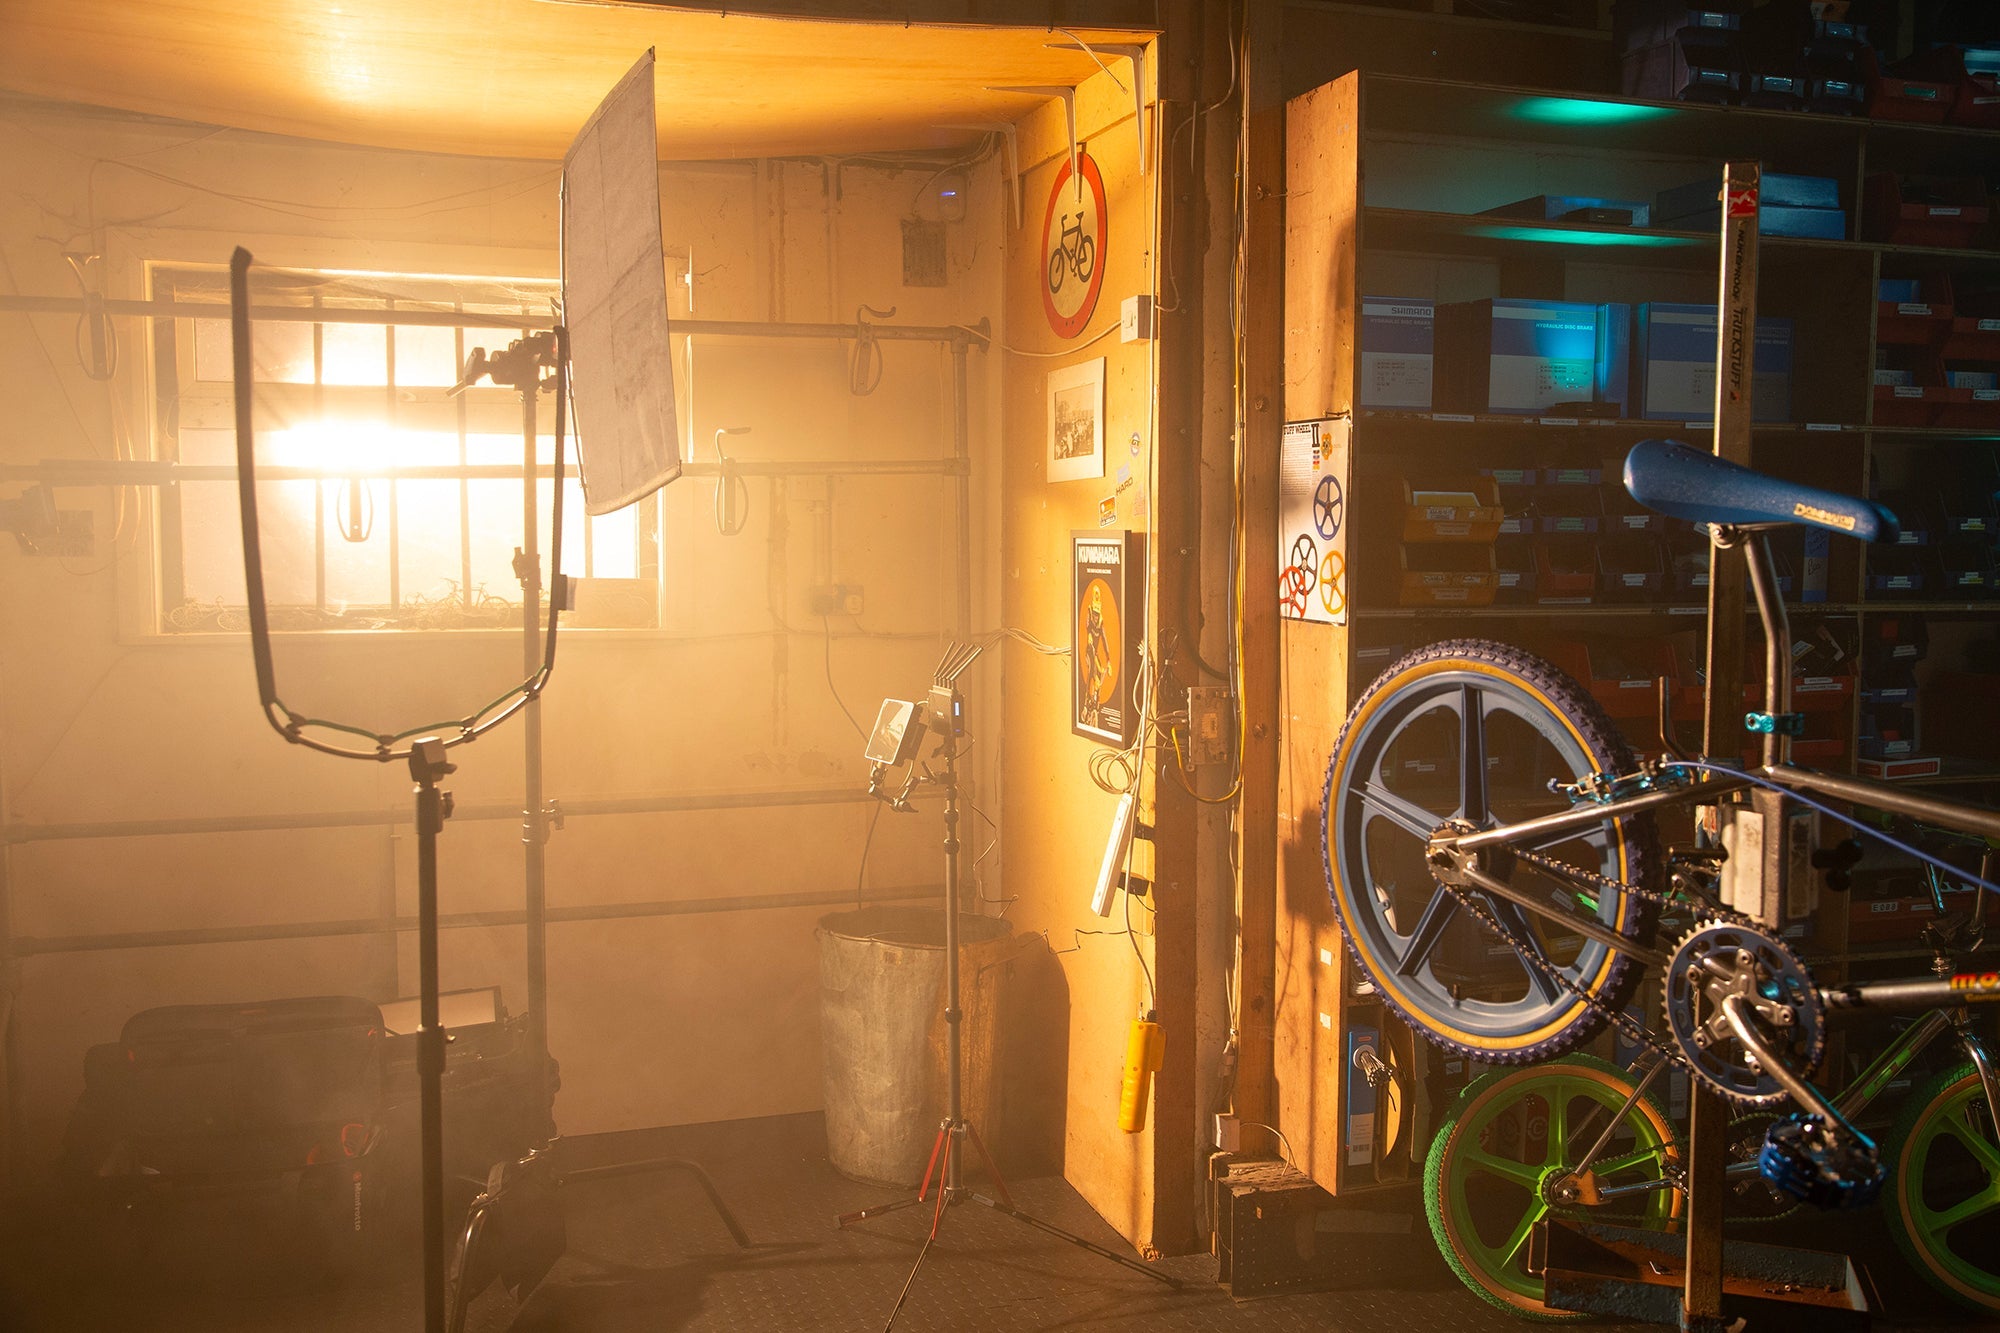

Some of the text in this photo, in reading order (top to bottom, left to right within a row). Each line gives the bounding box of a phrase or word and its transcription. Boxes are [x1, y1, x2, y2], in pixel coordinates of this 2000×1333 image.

[1733, 229, 1746, 302] NUKEPROOF
[1391, 306, 1432, 316] SHIMANO
[1535, 322, 1563, 330] HYDRAULIC
[1730, 308, 1744, 390] TRICKSTUFF
[1078, 546, 1120, 565] KUWAHARA
